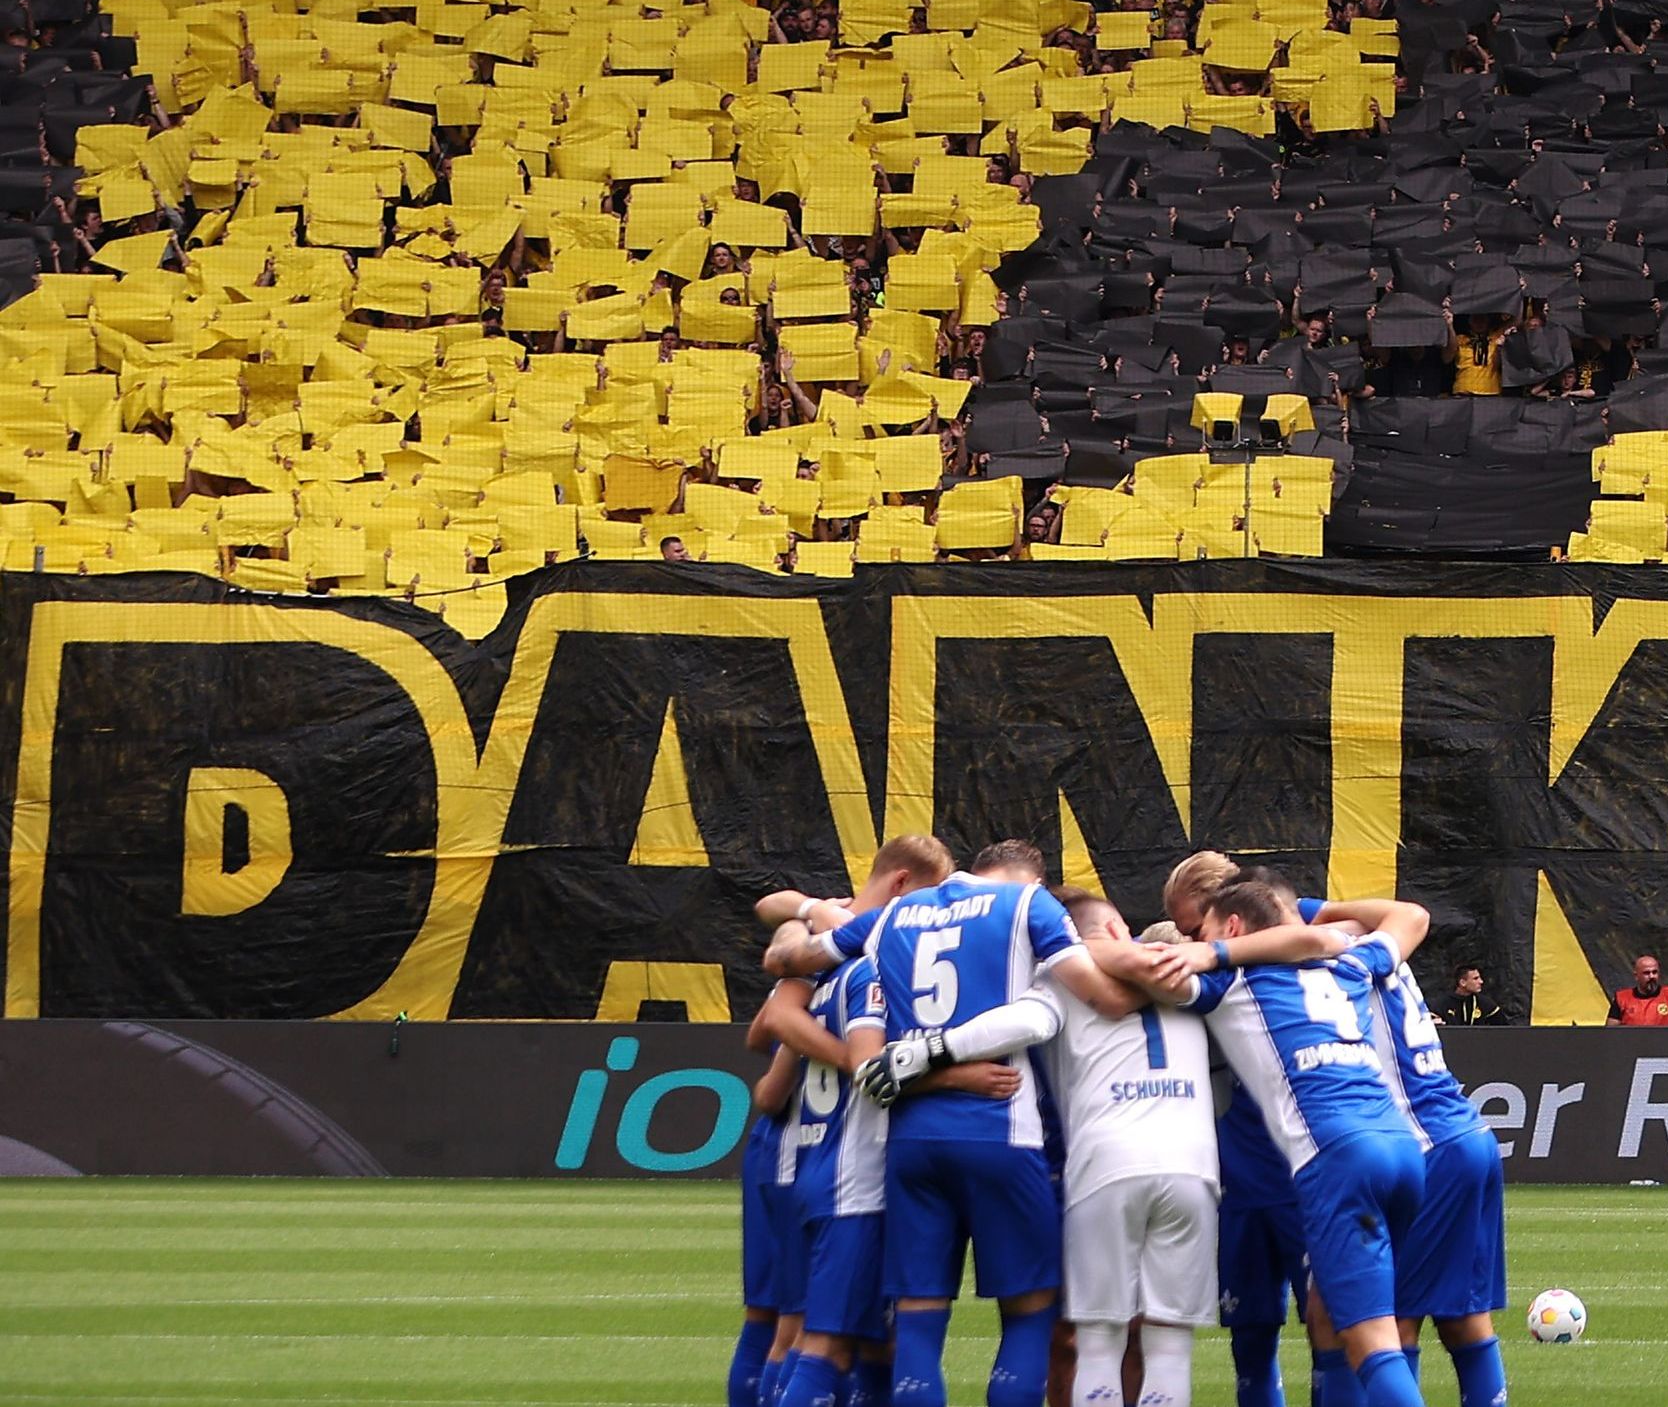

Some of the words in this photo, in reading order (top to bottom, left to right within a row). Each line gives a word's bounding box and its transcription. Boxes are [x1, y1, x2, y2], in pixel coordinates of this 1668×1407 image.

[911, 926, 962, 1027] 5
[1298, 967, 1365, 1042] 4
[1110, 1078, 1197, 1102] SCHUHEN
[1457, 1081, 1586, 1159] er
